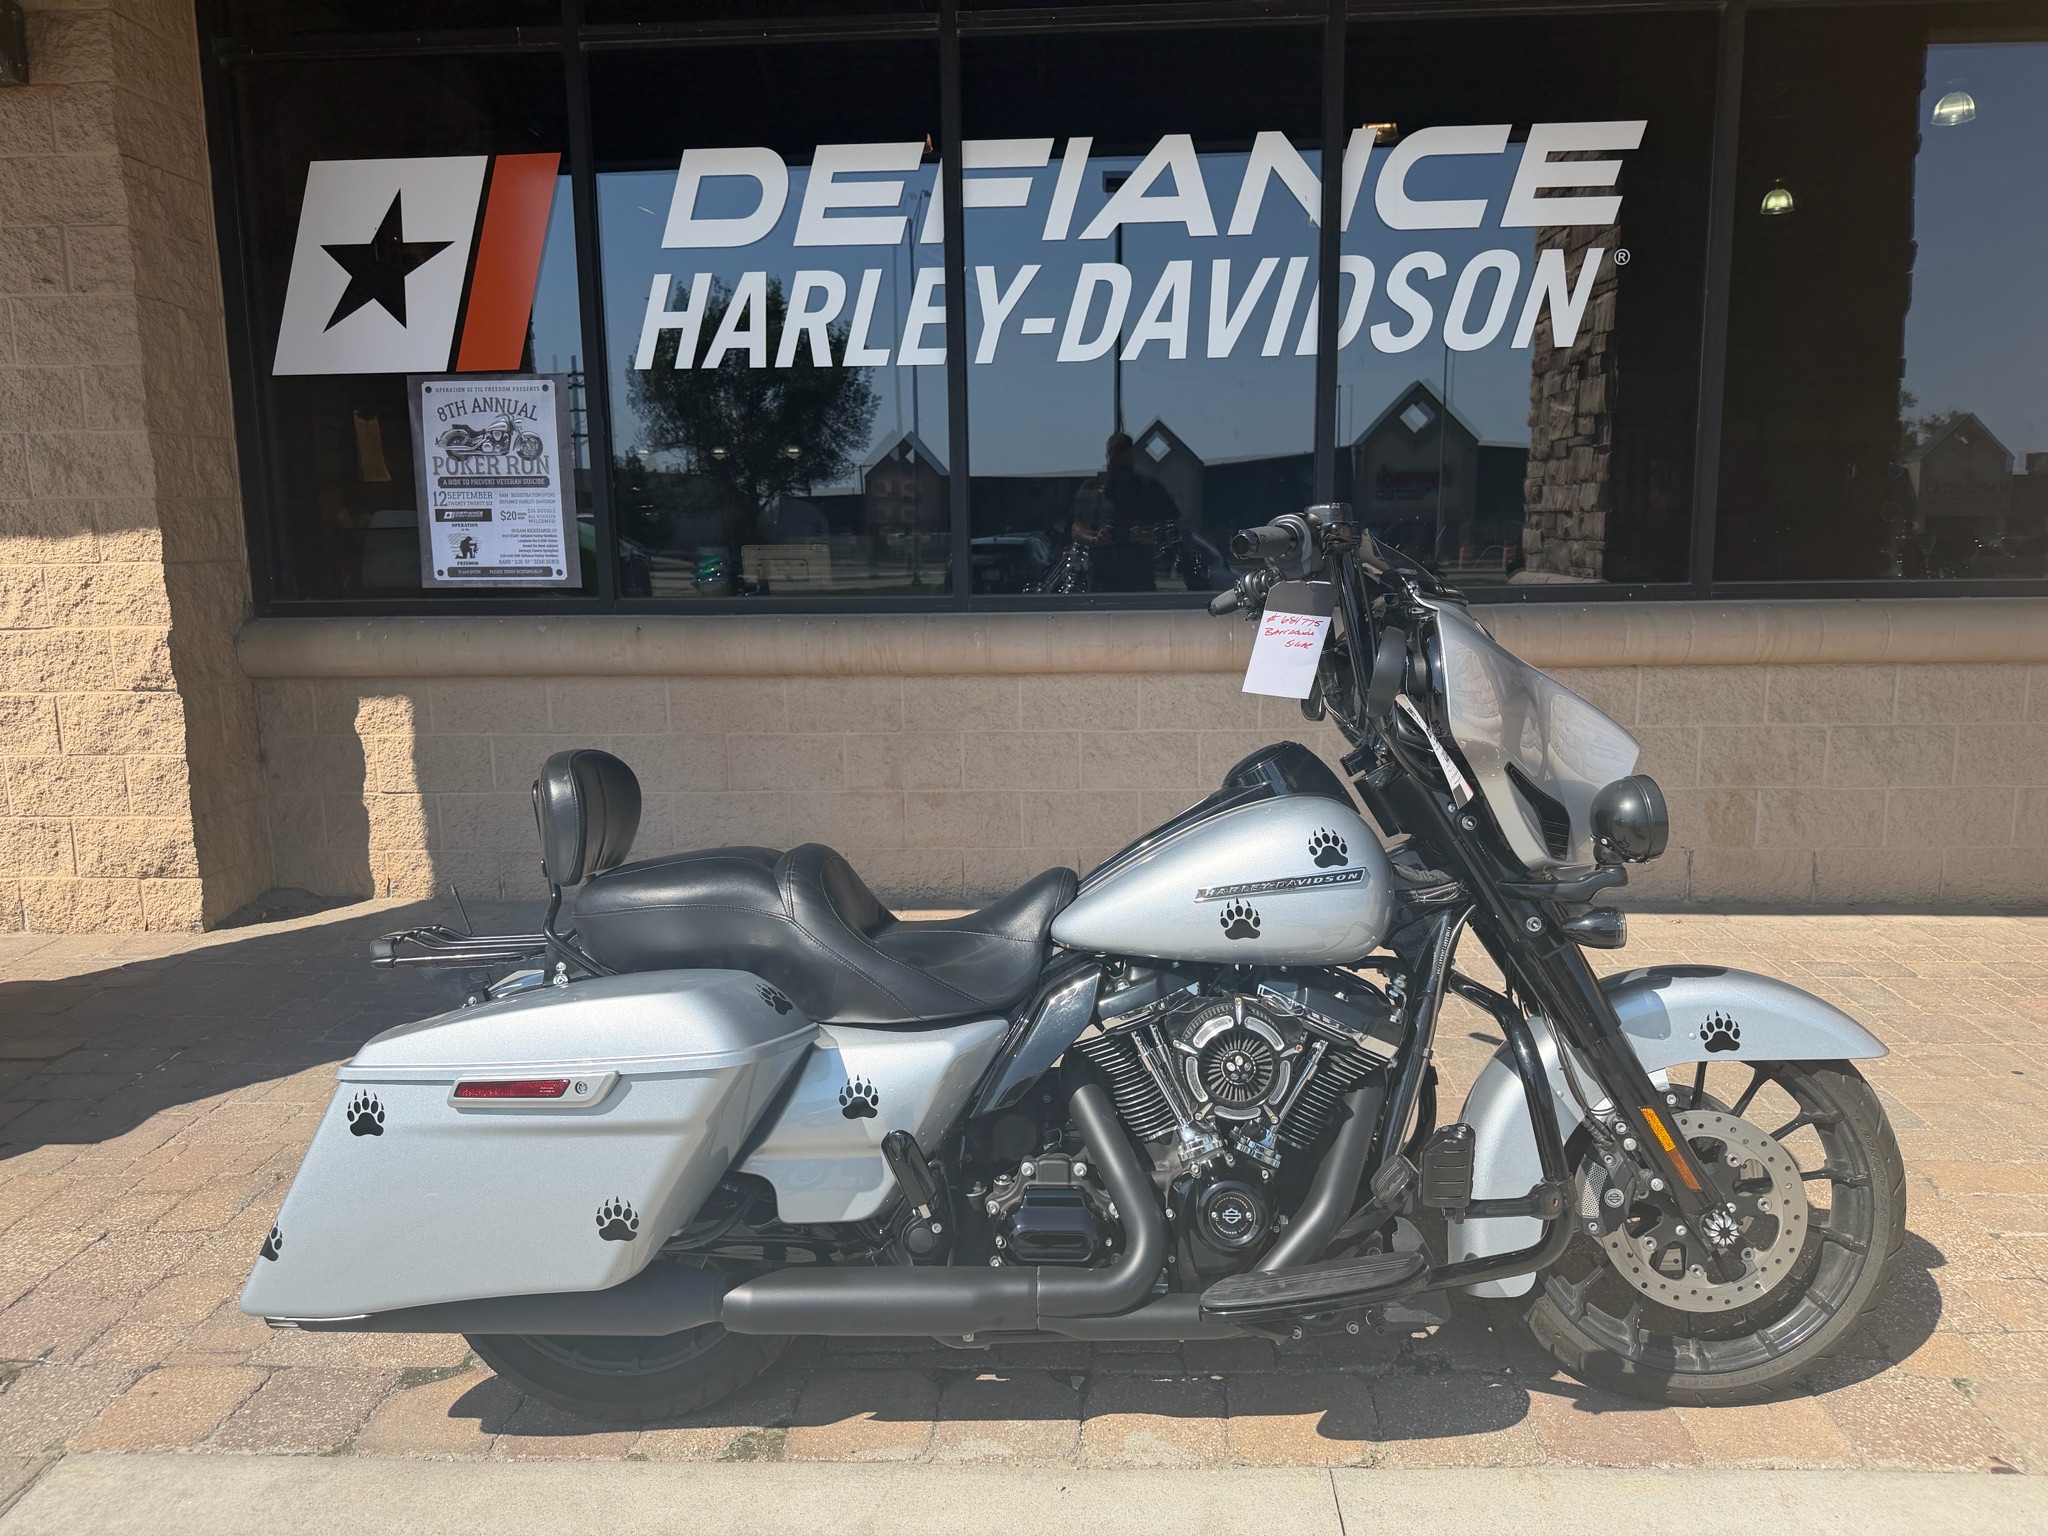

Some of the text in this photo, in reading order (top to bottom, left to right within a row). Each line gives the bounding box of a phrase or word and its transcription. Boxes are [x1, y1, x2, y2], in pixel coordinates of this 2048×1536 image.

[661, 120, 1648, 248] DEFIANCE
[634, 248, 1605, 370] HARLEY-DAVIDSON
[437, 397, 538, 422] 8TH ANNUAL
[433, 455, 550, 475] POKER RUN
[433, 491, 447, 507] 12
[447, 491, 493, 500] SEPTEMBER
[500, 510, 517, 521] $20
[1204, 872, 1359, 897] HARLEY-DAVIDSON
